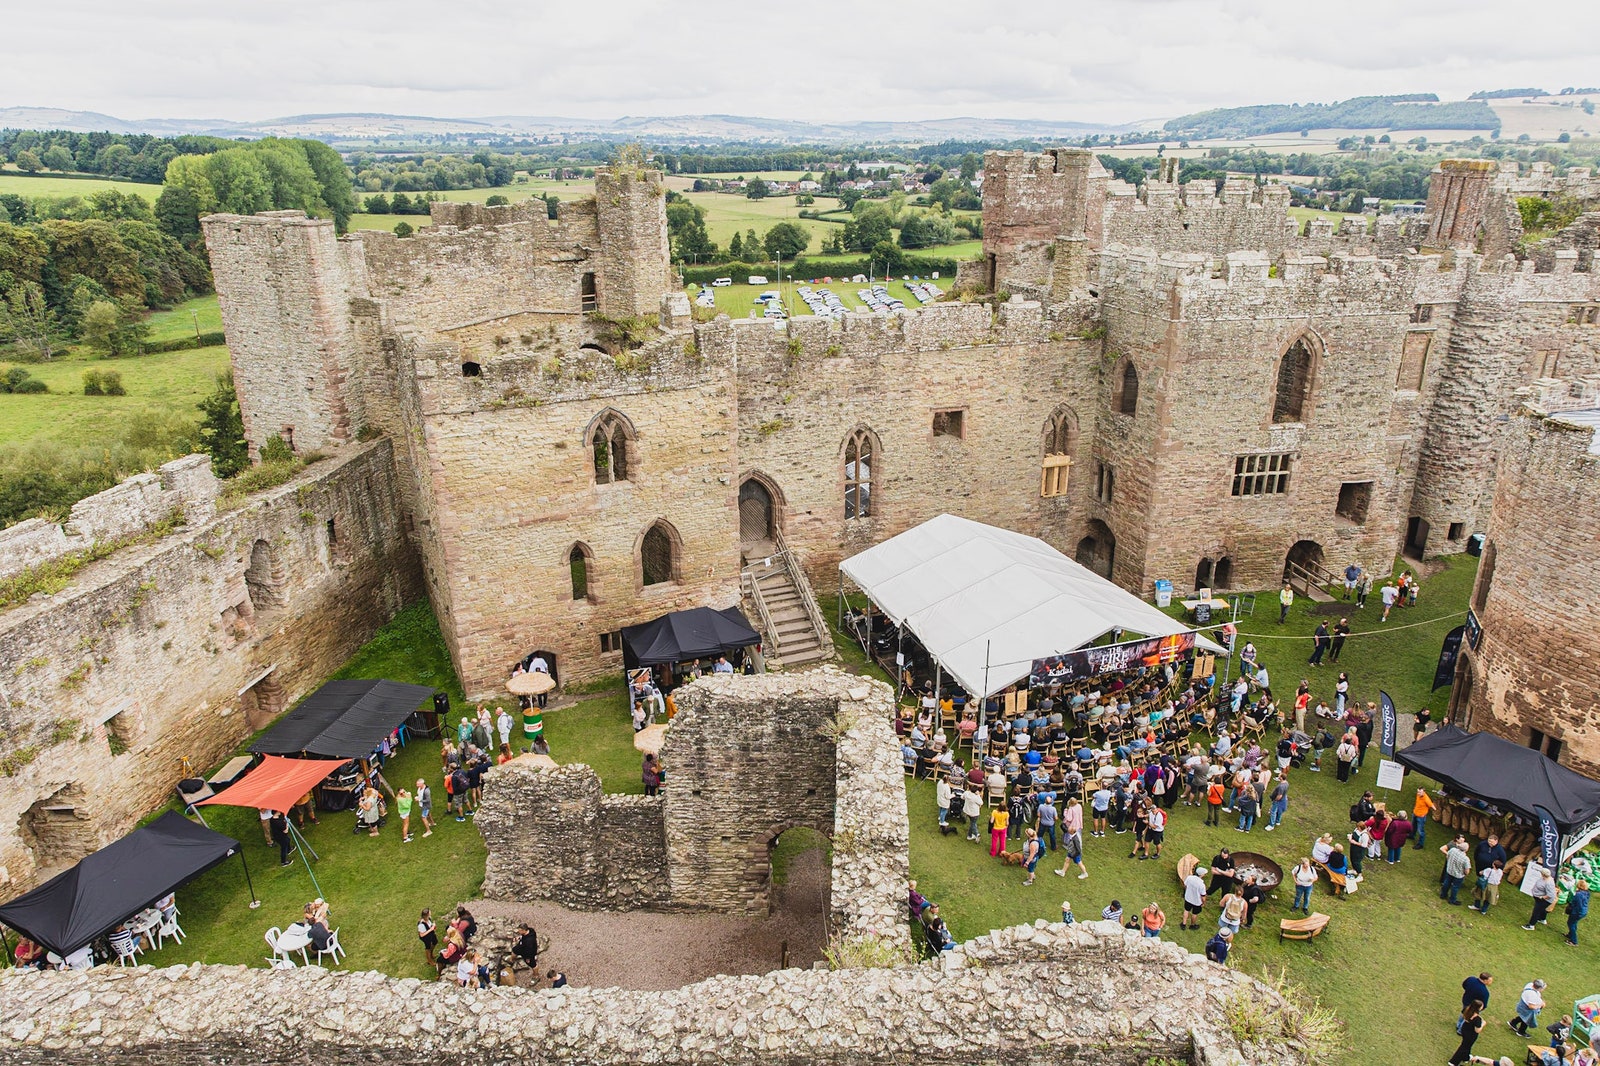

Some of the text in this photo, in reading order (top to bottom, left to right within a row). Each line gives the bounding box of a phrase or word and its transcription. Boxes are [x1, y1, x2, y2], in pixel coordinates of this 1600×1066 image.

[1107, 645, 1124, 655] THE
[1101, 650, 1129, 665] FIRE
[1048, 665, 1074, 677] Kadai
[1099, 661, 1128, 674] STAGE
